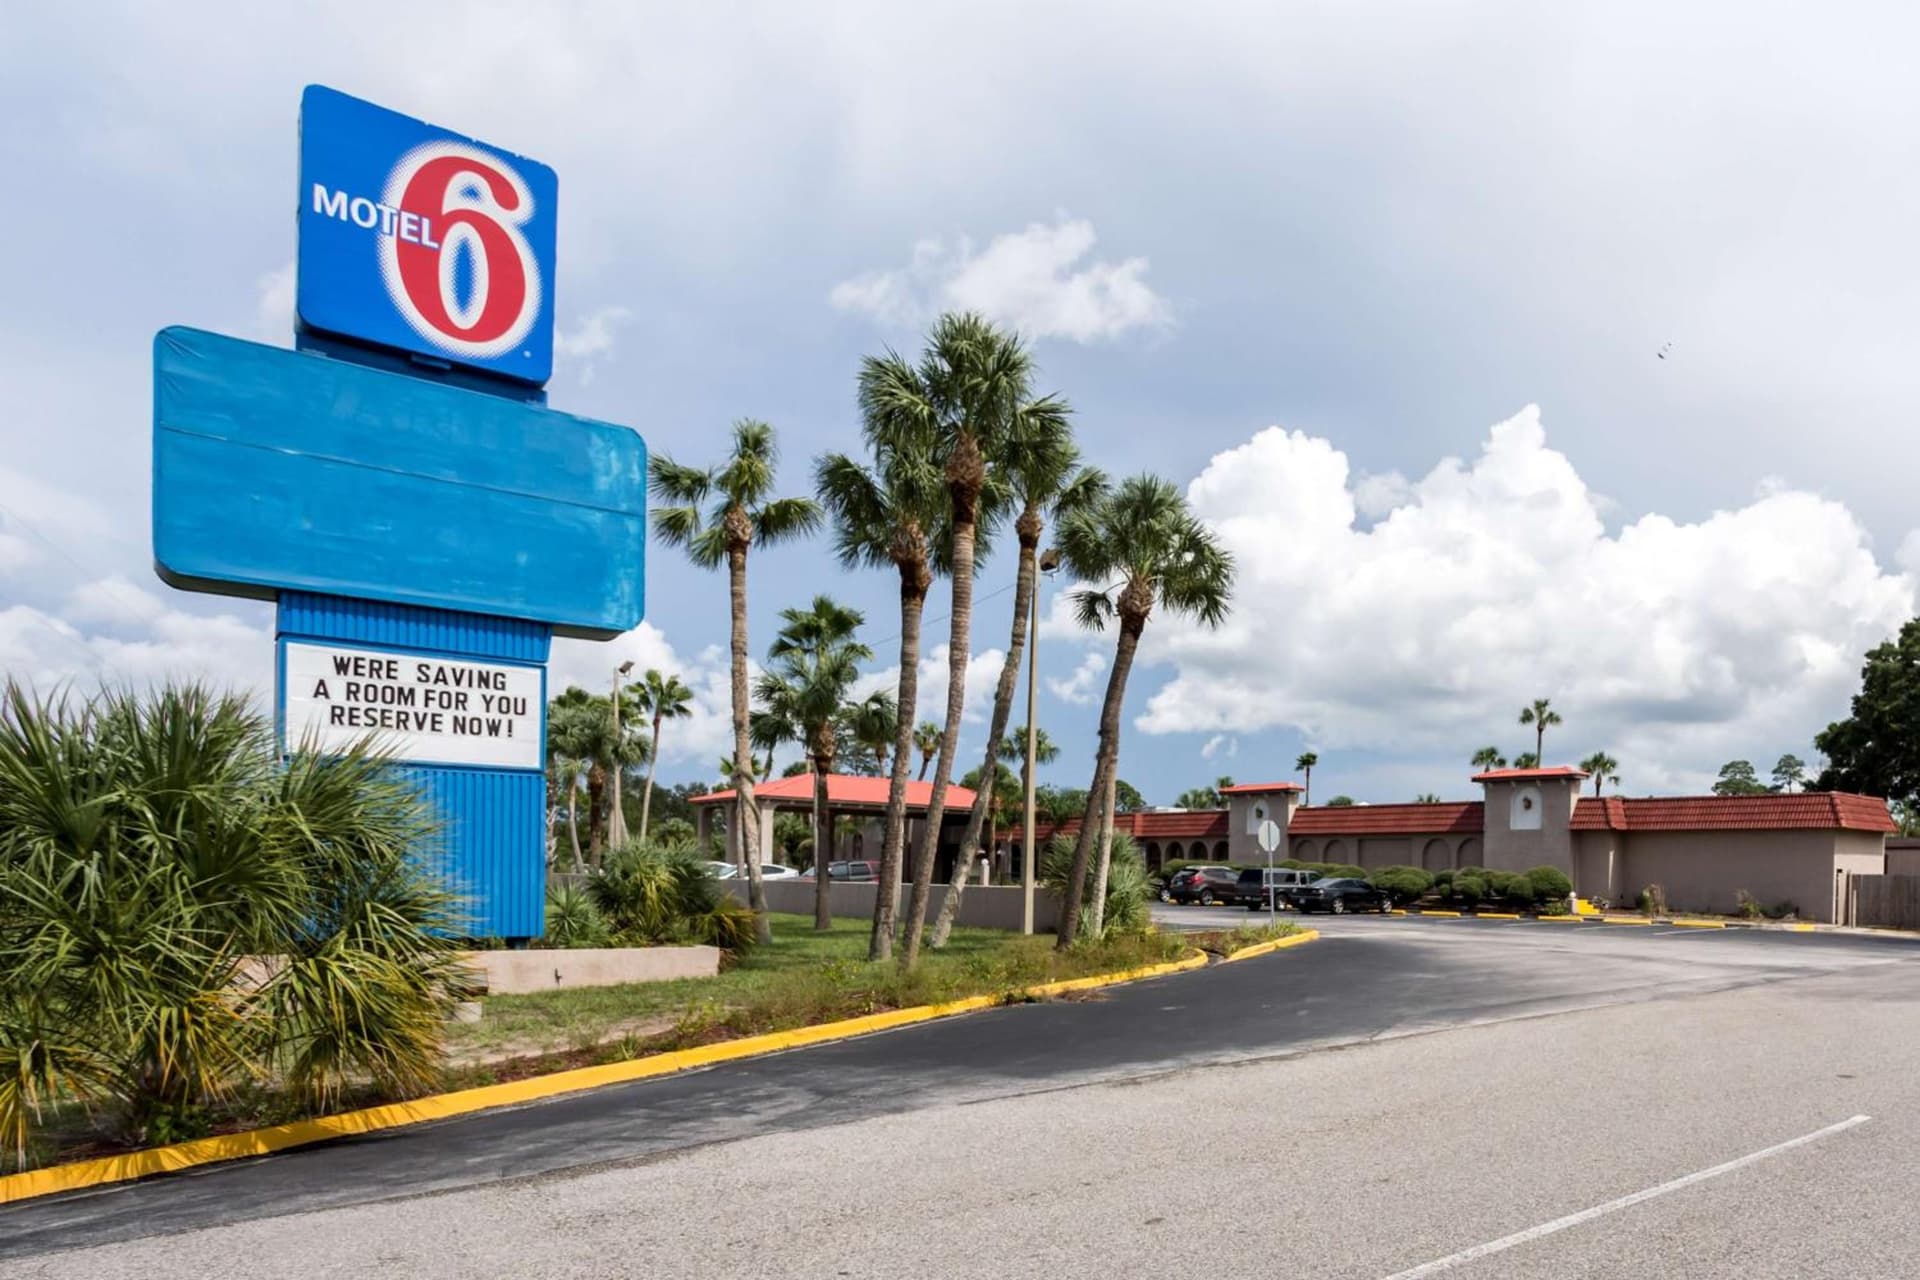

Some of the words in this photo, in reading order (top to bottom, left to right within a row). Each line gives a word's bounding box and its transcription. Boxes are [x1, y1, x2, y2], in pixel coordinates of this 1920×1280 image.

[312, 183, 439, 249] MOTEL
[396, 155, 526, 343] 6
[333, 655, 398, 680] WERE
[416, 663, 507, 691] SAVING
[313, 679, 330, 699] A
[346, 682, 415, 707] ROOM
[424, 689, 467, 711] FOR
[481, 694, 526, 716] YOU
[330, 705, 443, 732] RESERVE
[453, 715, 513, 737] NOW!
